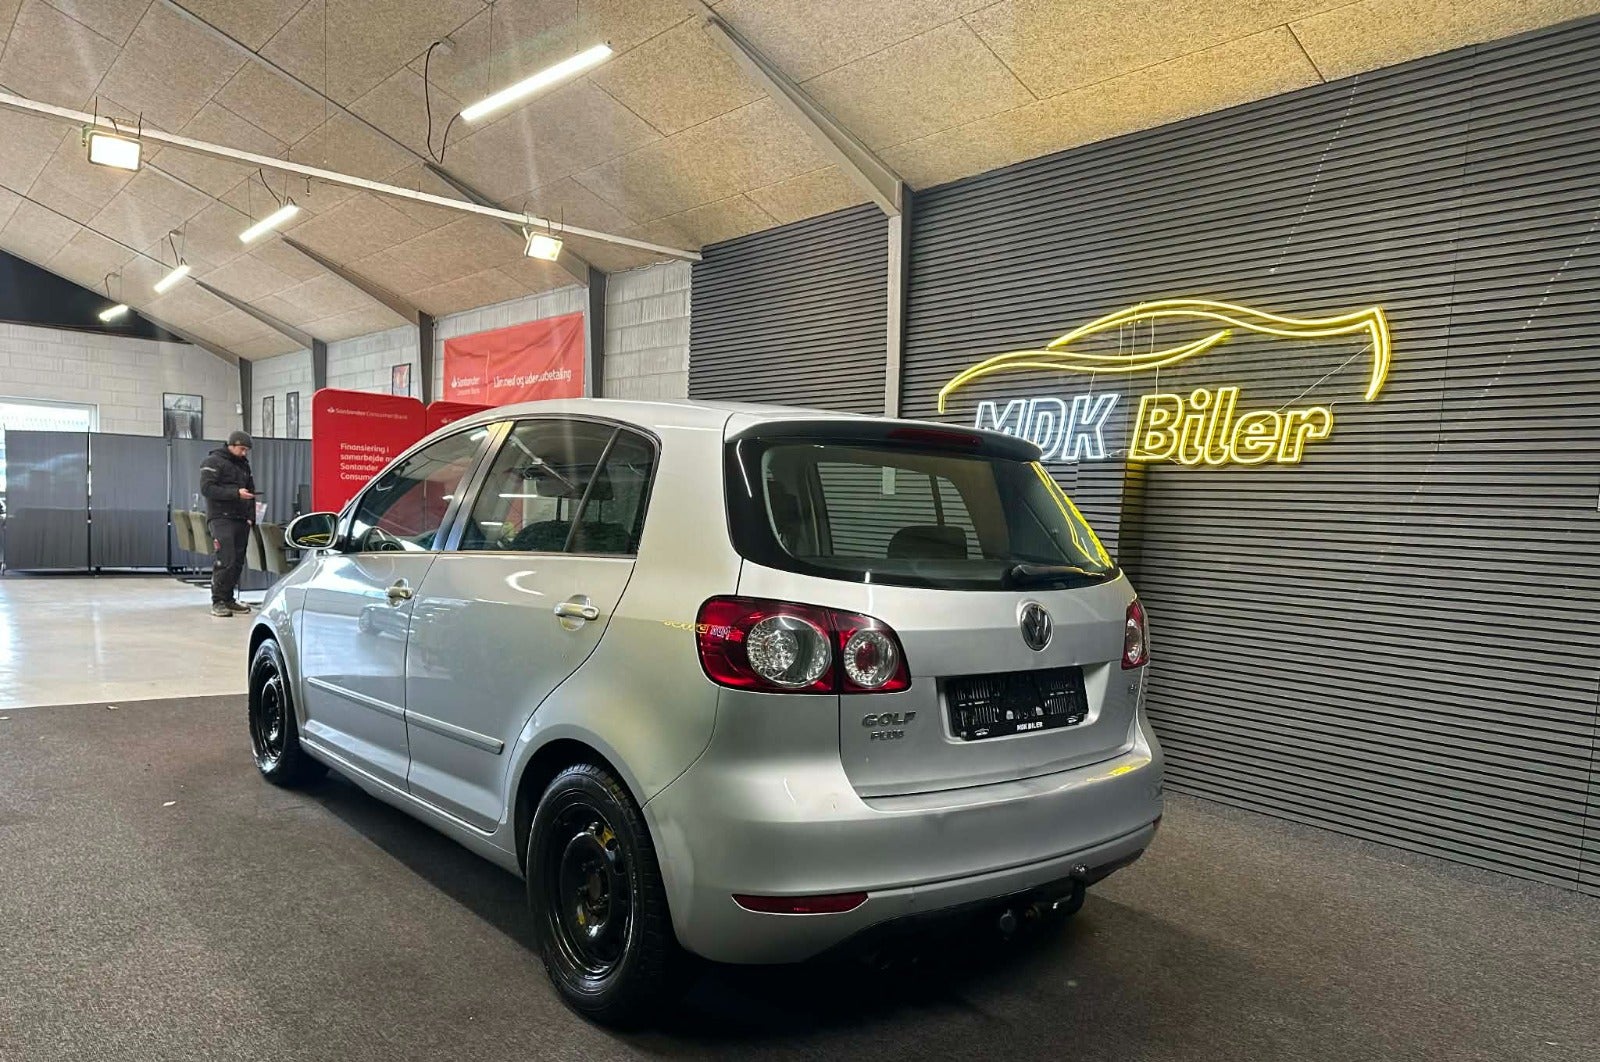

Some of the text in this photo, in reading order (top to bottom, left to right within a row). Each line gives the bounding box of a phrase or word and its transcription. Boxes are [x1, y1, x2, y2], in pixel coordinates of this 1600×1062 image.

[516, 377, 525, 388] og
[974, 386, 1334, 466] MDK Biler
[340, 442, 386, 455] Finansiering
[340, 453, 384, 464] samarbejde
[340, 462, 378, 472] Santander
[340, 472, 372, 481] Consum
[862, 710, 917, 728] GOLF
[870, 730, 905, 741] PLUS
